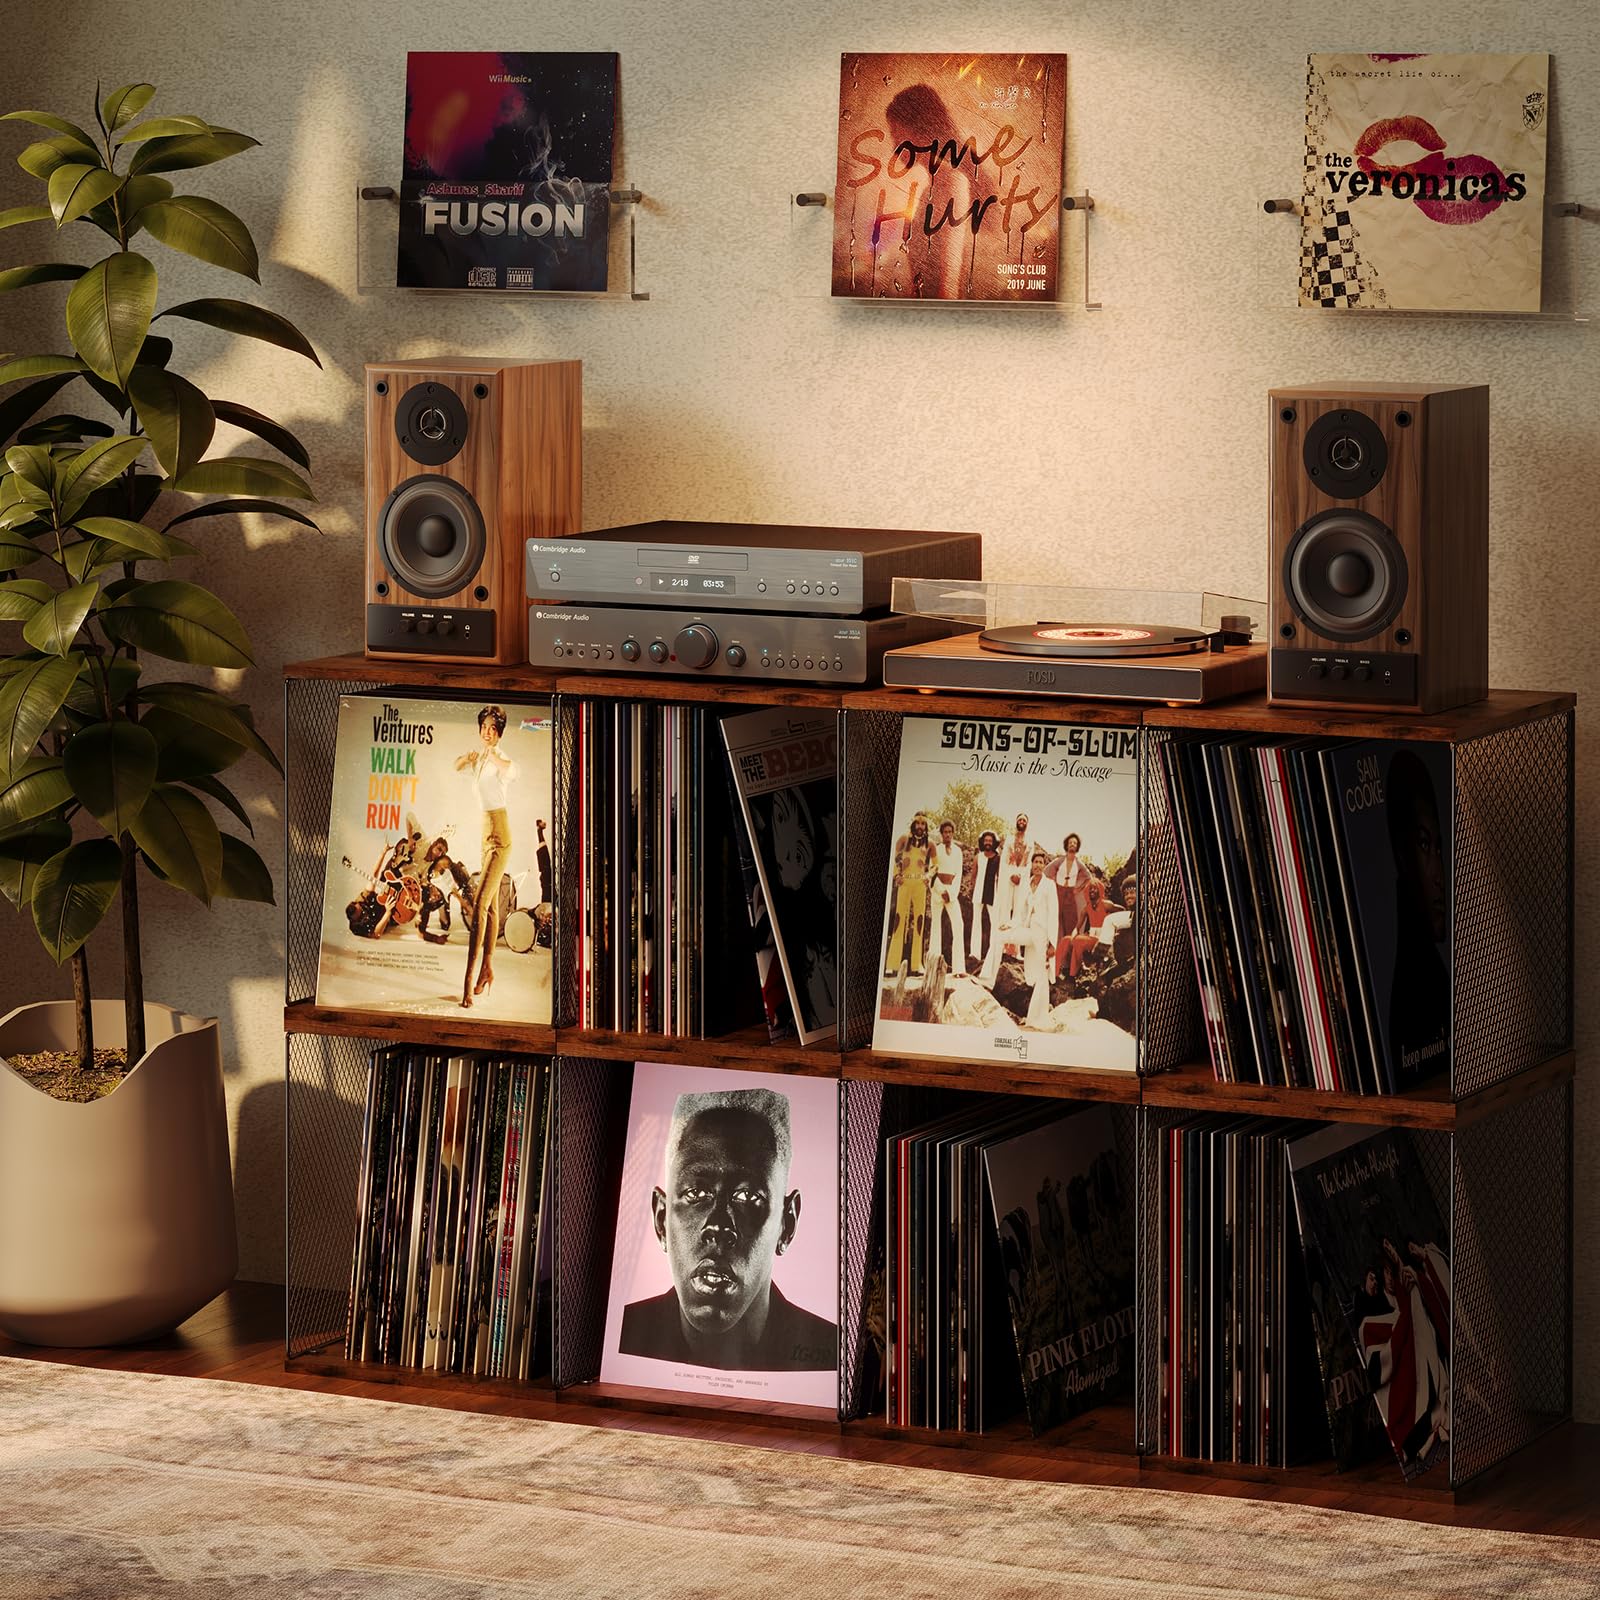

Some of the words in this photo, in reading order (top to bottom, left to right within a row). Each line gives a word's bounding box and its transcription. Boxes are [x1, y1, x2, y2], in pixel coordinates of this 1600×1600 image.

[847, 125, 1033, 188] Some
[1324, 152, 1353, 168] the
[1325, 161, 1527, 204] veronicas
[424, 201, 585, 238] FUSION
[871, 174, 1058, 246] Hurts
[997, 264, 1025, 275] SONG'S
[1026, 265, 1047, 275] CLUB
[1007, 279, 1025, 290] 2019
[1025, 280, 1047, 291] JUNE
[539, 545, 568, 554] Cambridge
[569, 546, 587, 554] Audio
[542, 612, 572, 621] Cambridge
[573, 613, 590, 621] Audio
[382, 704, 399, 722] The
[373, 716, 434, 745] Ventures
[370, 747, 416, 775] WALK
[740, 753, 763, 769] MEET
[743, 765, 767, 783] THE
[961, 753, 1011, 775] Music
[1013, 756, 1025, 775] is
[1028, 757, 1048, 776] the
[1051, 759, 1113, 784] Message
[1356, 754, 1381, 784] SAM
[368, 775, 419, 804] DON'T
[1346, 779, 1385, 813] COOKE
[365, 803, 400, 831] RUN
[1317, 1168, 1336, 1200] The
[1333, 1160, 1357, 1193] Kids
[1027, 1333, 1079, 1383] PINK
[1330, 1364, 1371, 1411] PIN
